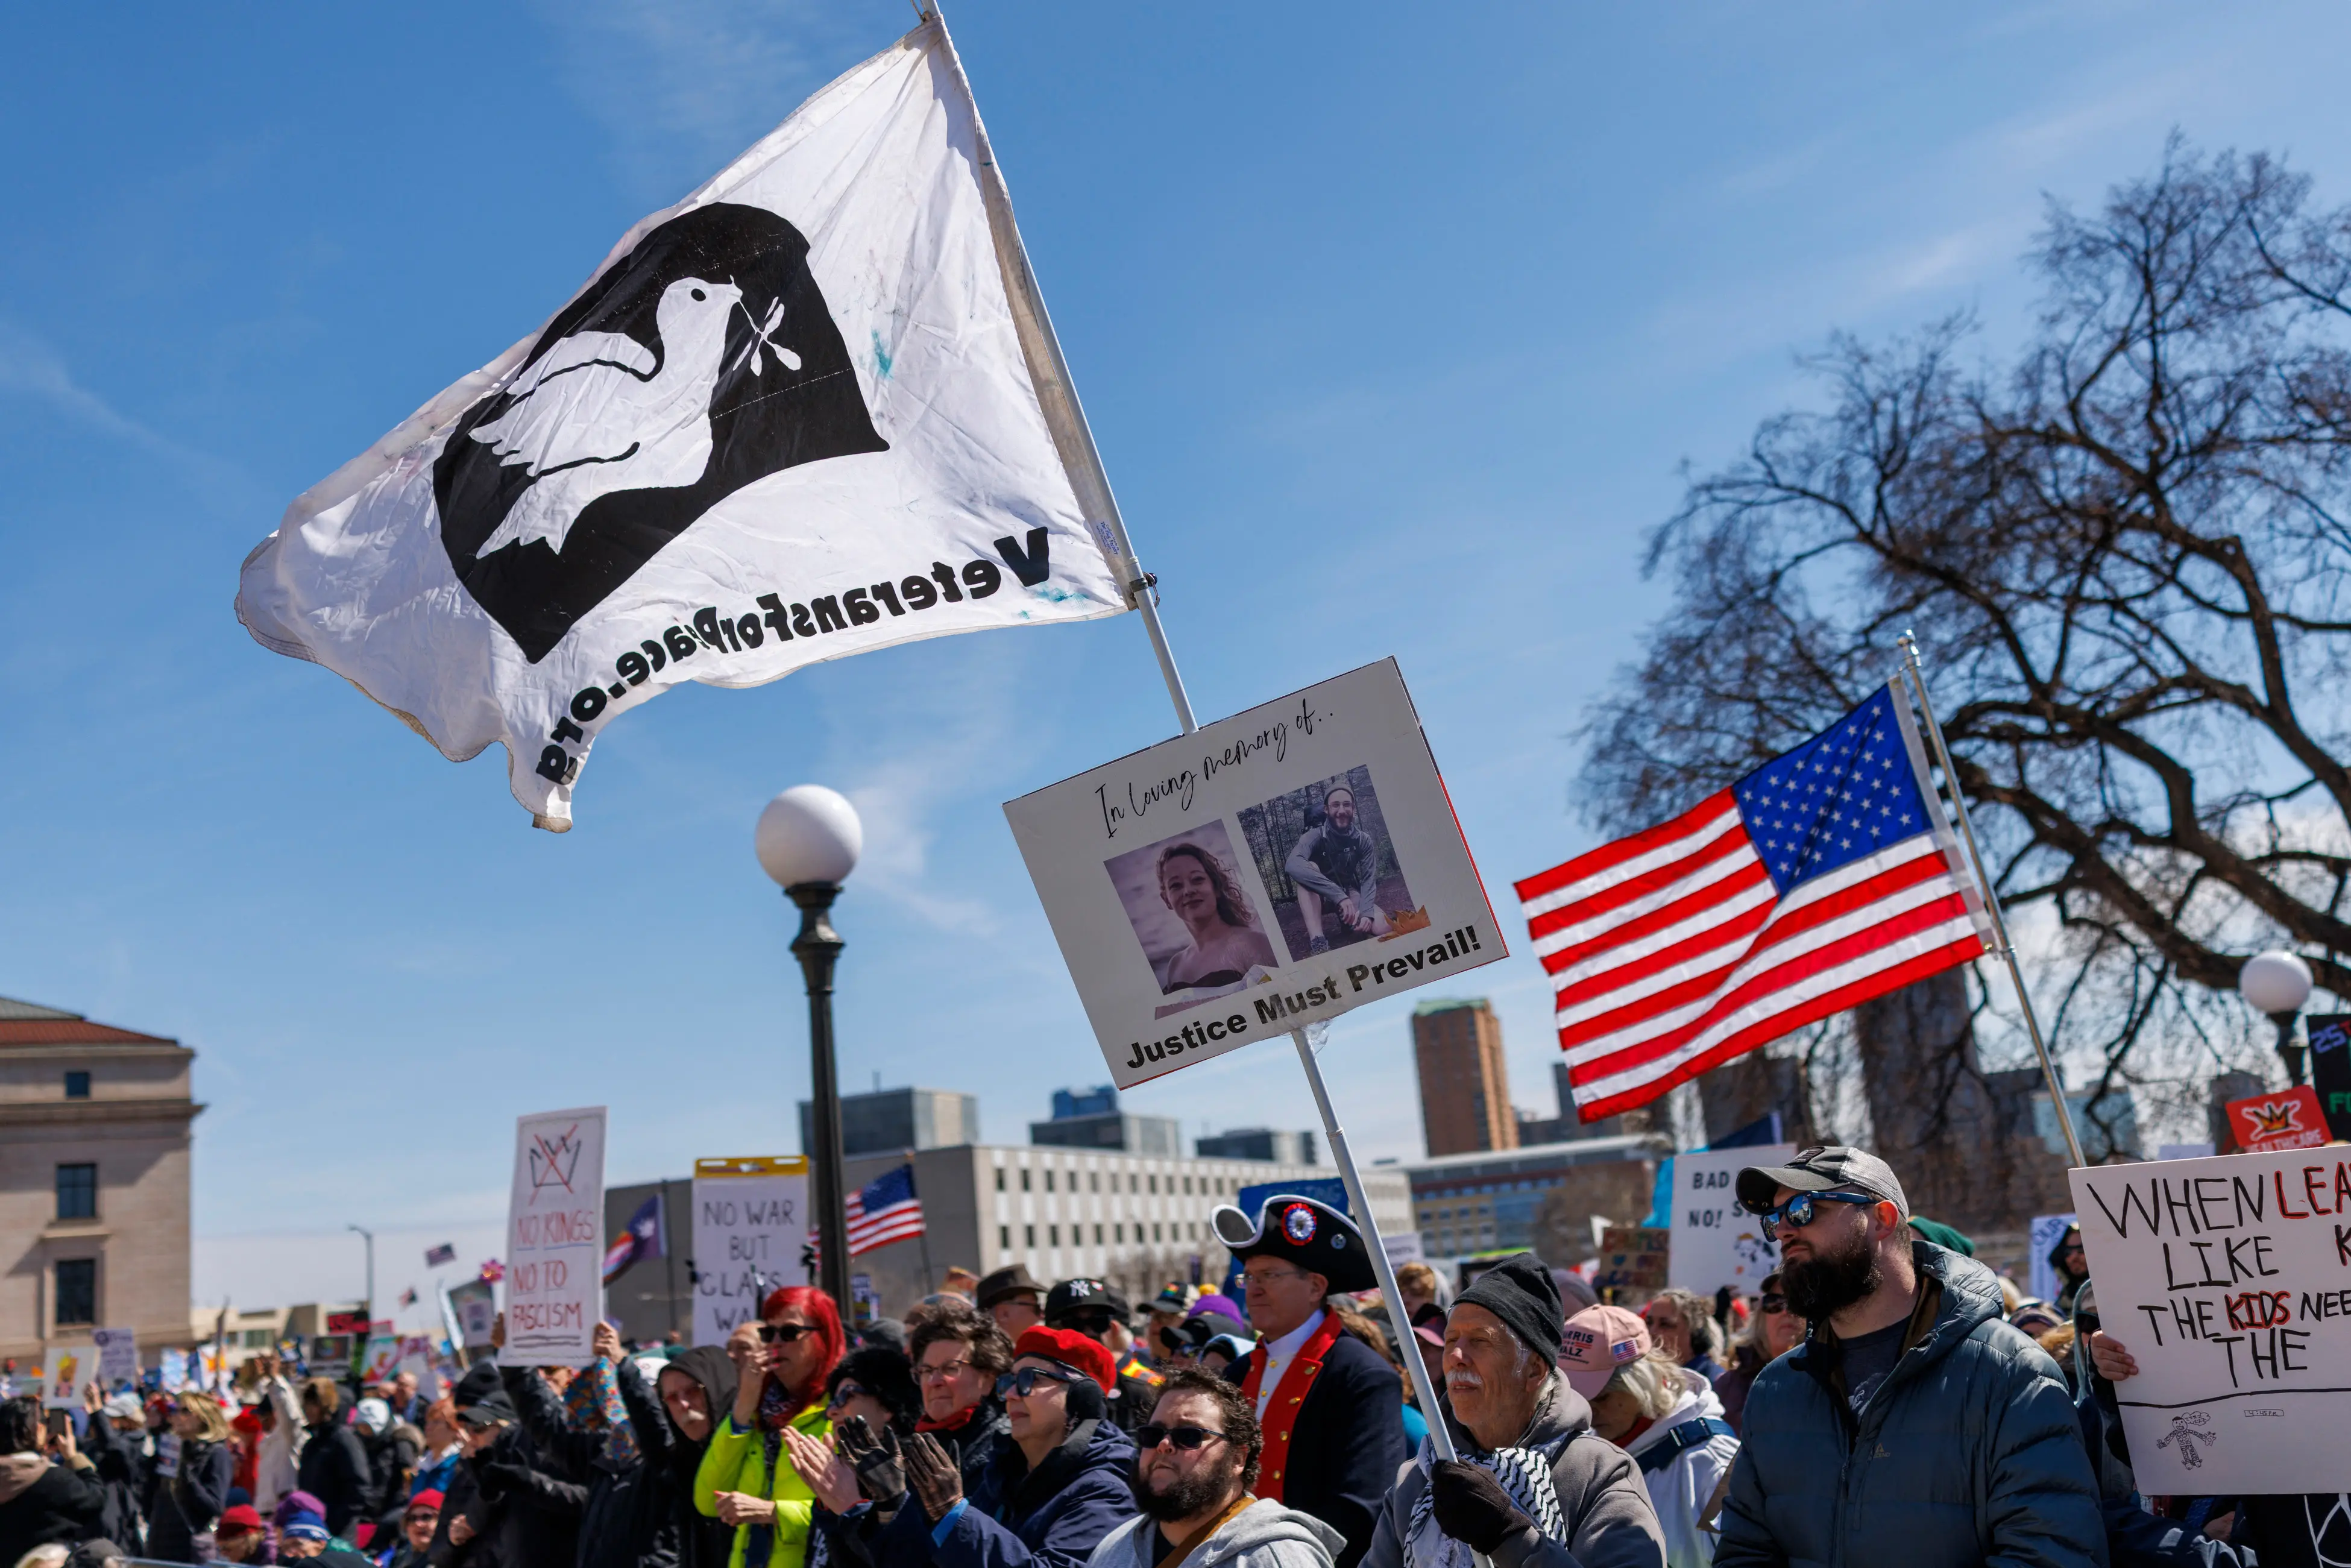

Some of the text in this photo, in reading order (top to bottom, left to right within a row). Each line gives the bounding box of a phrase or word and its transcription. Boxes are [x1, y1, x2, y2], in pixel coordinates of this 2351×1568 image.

[1109, 540, 1118, 555] Factory
[1095, 783, 1125, 839] In
[1204, 723, 1288, 781] memory
[1127, 925, 1481, 1069] Justice Must Prevail!
[1693, 1171, 1730, 1190] BAD
[703, 1199, 795, 1226] NO WAR
[2086, 1162, 2351, 1239] WHEN LEA
[516, 1209, 594, 1245] NO KINGS
[1688, 1209, 1723, 1229] NO!
[729, 1235, 770, 1261] BUT
[2163, 1236, 2279, 1291] LIKE
[513, 1260, 568, 1291] NO TO
[512, 1301, 583, 1331] FASCISM
[2137, 1296, 2221, 1346] THE
[2224, 1291, 2290, 1331] KIDS
[1563, 1330, 1594, 1344] ARRIS
[2212, 1328, 2311, 1388] THE
